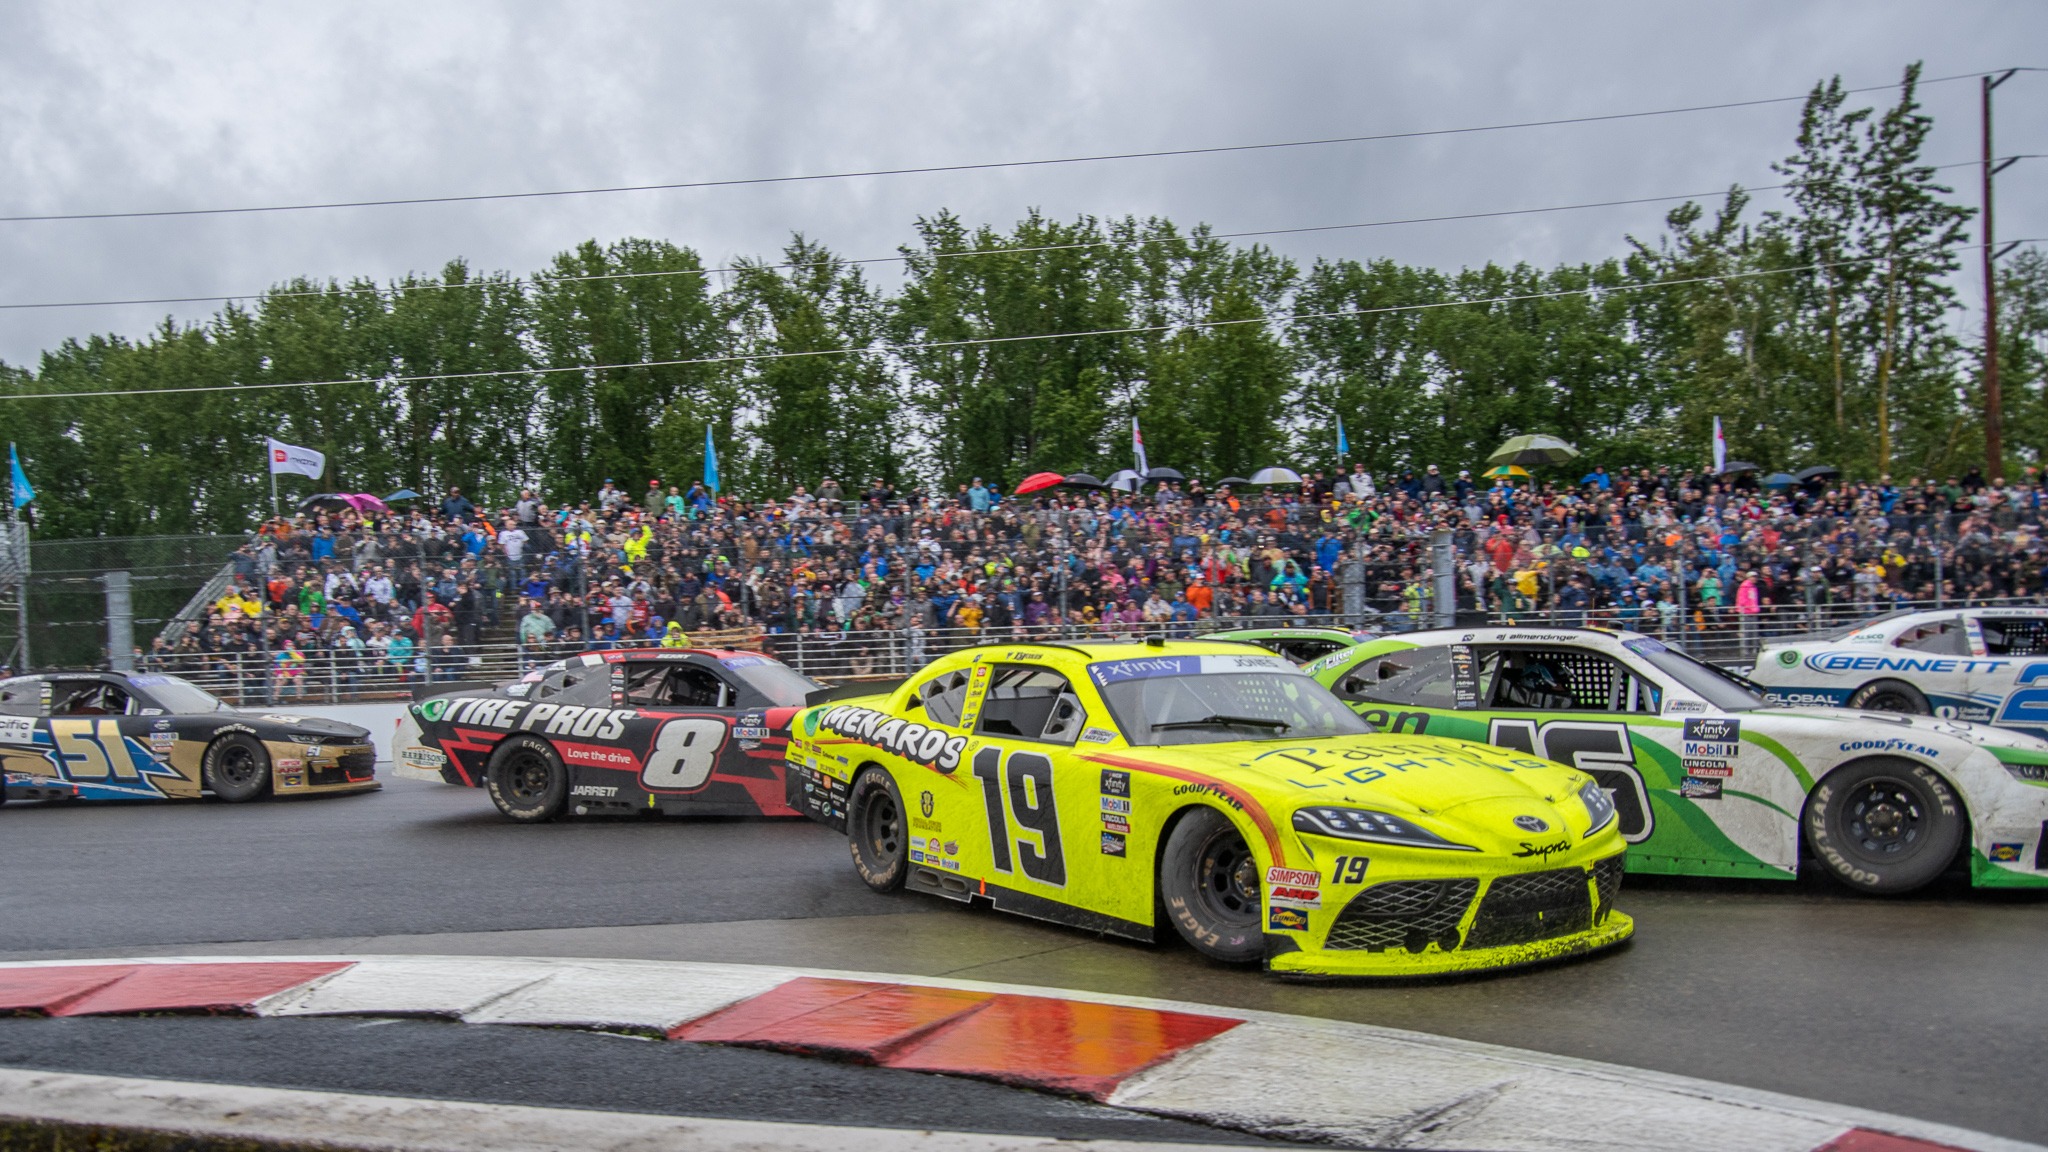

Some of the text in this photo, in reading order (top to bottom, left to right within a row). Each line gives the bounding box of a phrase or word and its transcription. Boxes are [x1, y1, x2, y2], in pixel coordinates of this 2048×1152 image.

[1496, 633, 1579, 642] aj allmendinger
[1106, 658, 1181, 677] xfinity
[1233, 658, 1280, 668] JONES
[1823, 656, 2011, 675] BENNETT
[1764, 693, 1840, 704] GLOBAL
[441, 697, 638, 740] TIRE PROS
[1957, 712, 1991, 721] Rentals
[1958, 705, 1989, 714] United
[821, 705, 968, 772] MENARDS
[1693, 724, 1731, 738] xfinity
[48, 718, 140, 781] 51
[305, 744, 321, 757] 51
[521, 739, 553, 760] EAGLE
[566, 747, 632, 765] Love the drive
[641, 717, 729, 790] 8
[1685, 742, 1723, 756] Mobil
[1839, 738, 1939, 759] GOODYEAR
[1683, 759, 1726, 769] LINCOLN
[1692, 768, 1729, 777] WELDERS
[865, 772, 892, 791] EAGLE
[1105, 778, 1127, 792] xfinity
[1912, 764, 1957, 817] EAGLE
[570, 785, 619, 797] JARRETT
[1173, 782, 1245, 812] GOODYEAR
[1101, 797, 1122, 810] Mobil
[972, 746, 1067, 889] 19
[1101, 812, 1127, 825] LINCOLN
[1812, 784, 1881, 887] GOODYEAR
[1511, 840, 1572, 864] Supra
[1269, 868, 1318, 887] SIMPSON
[1331, 855, 1371, 885] 19
[1271, 886, 1320, 901] ARP
[1170, 896, 1221, 948] EAGLE
[1271, 914, 1307, 925] SUNOCO
